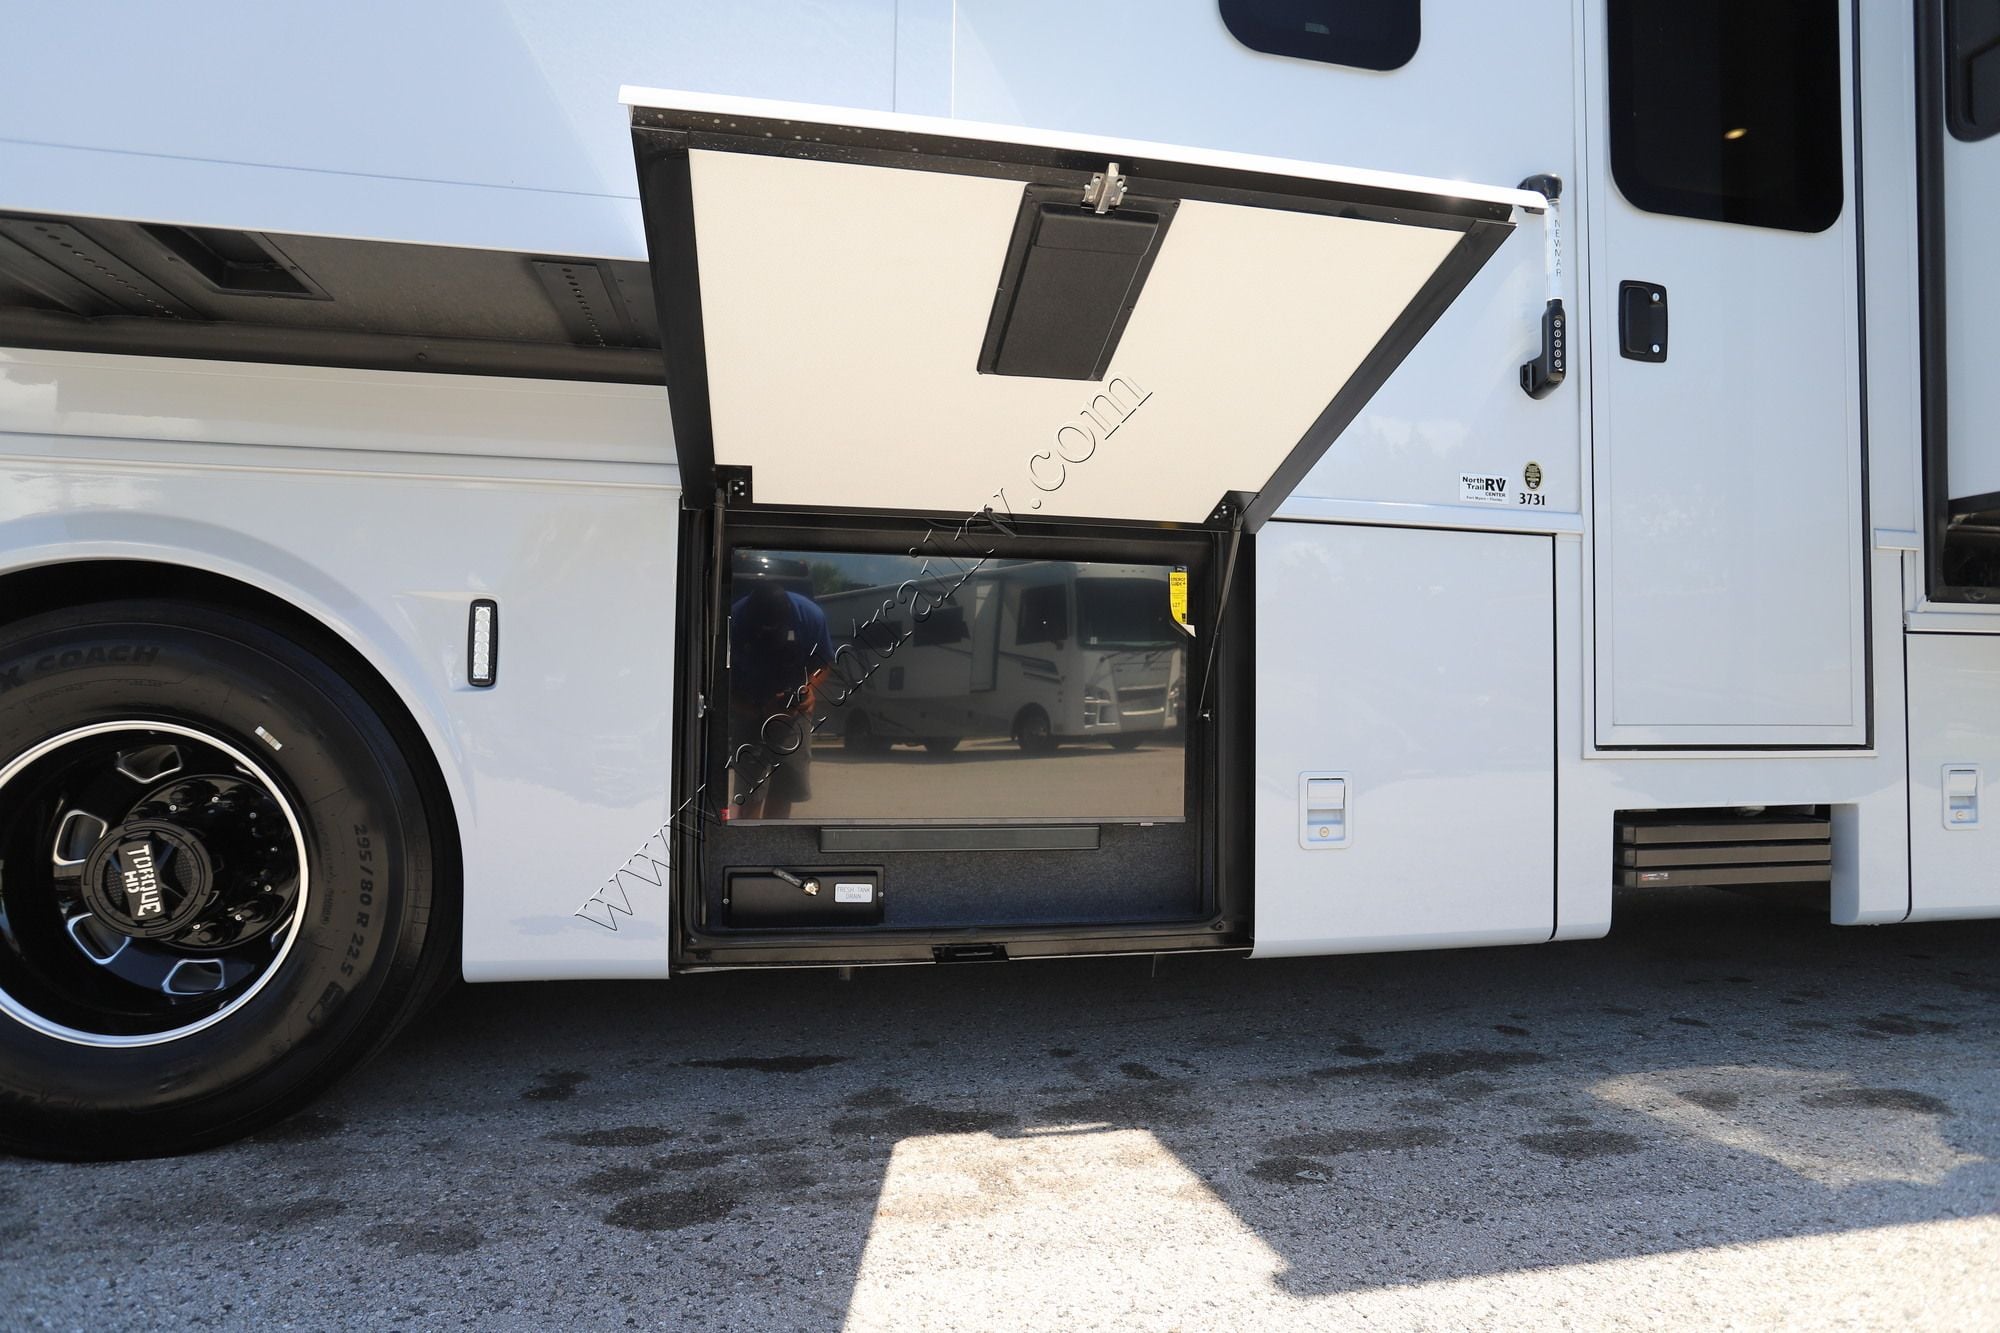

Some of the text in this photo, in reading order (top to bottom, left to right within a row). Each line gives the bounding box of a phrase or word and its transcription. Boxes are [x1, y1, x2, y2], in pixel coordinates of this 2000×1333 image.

[1554, 219, 1562, 277] NEWMAR
[1462, 476, 1506, 492] North RV
[1519, 492, 1545, 506] 3731
[35, 645, 160, 671] COACH
[124, 870, 141, 893] HD
[127, 844, 161, 917] TORQUE
[340, 823, 375, 978] 295/80 R 22.5
